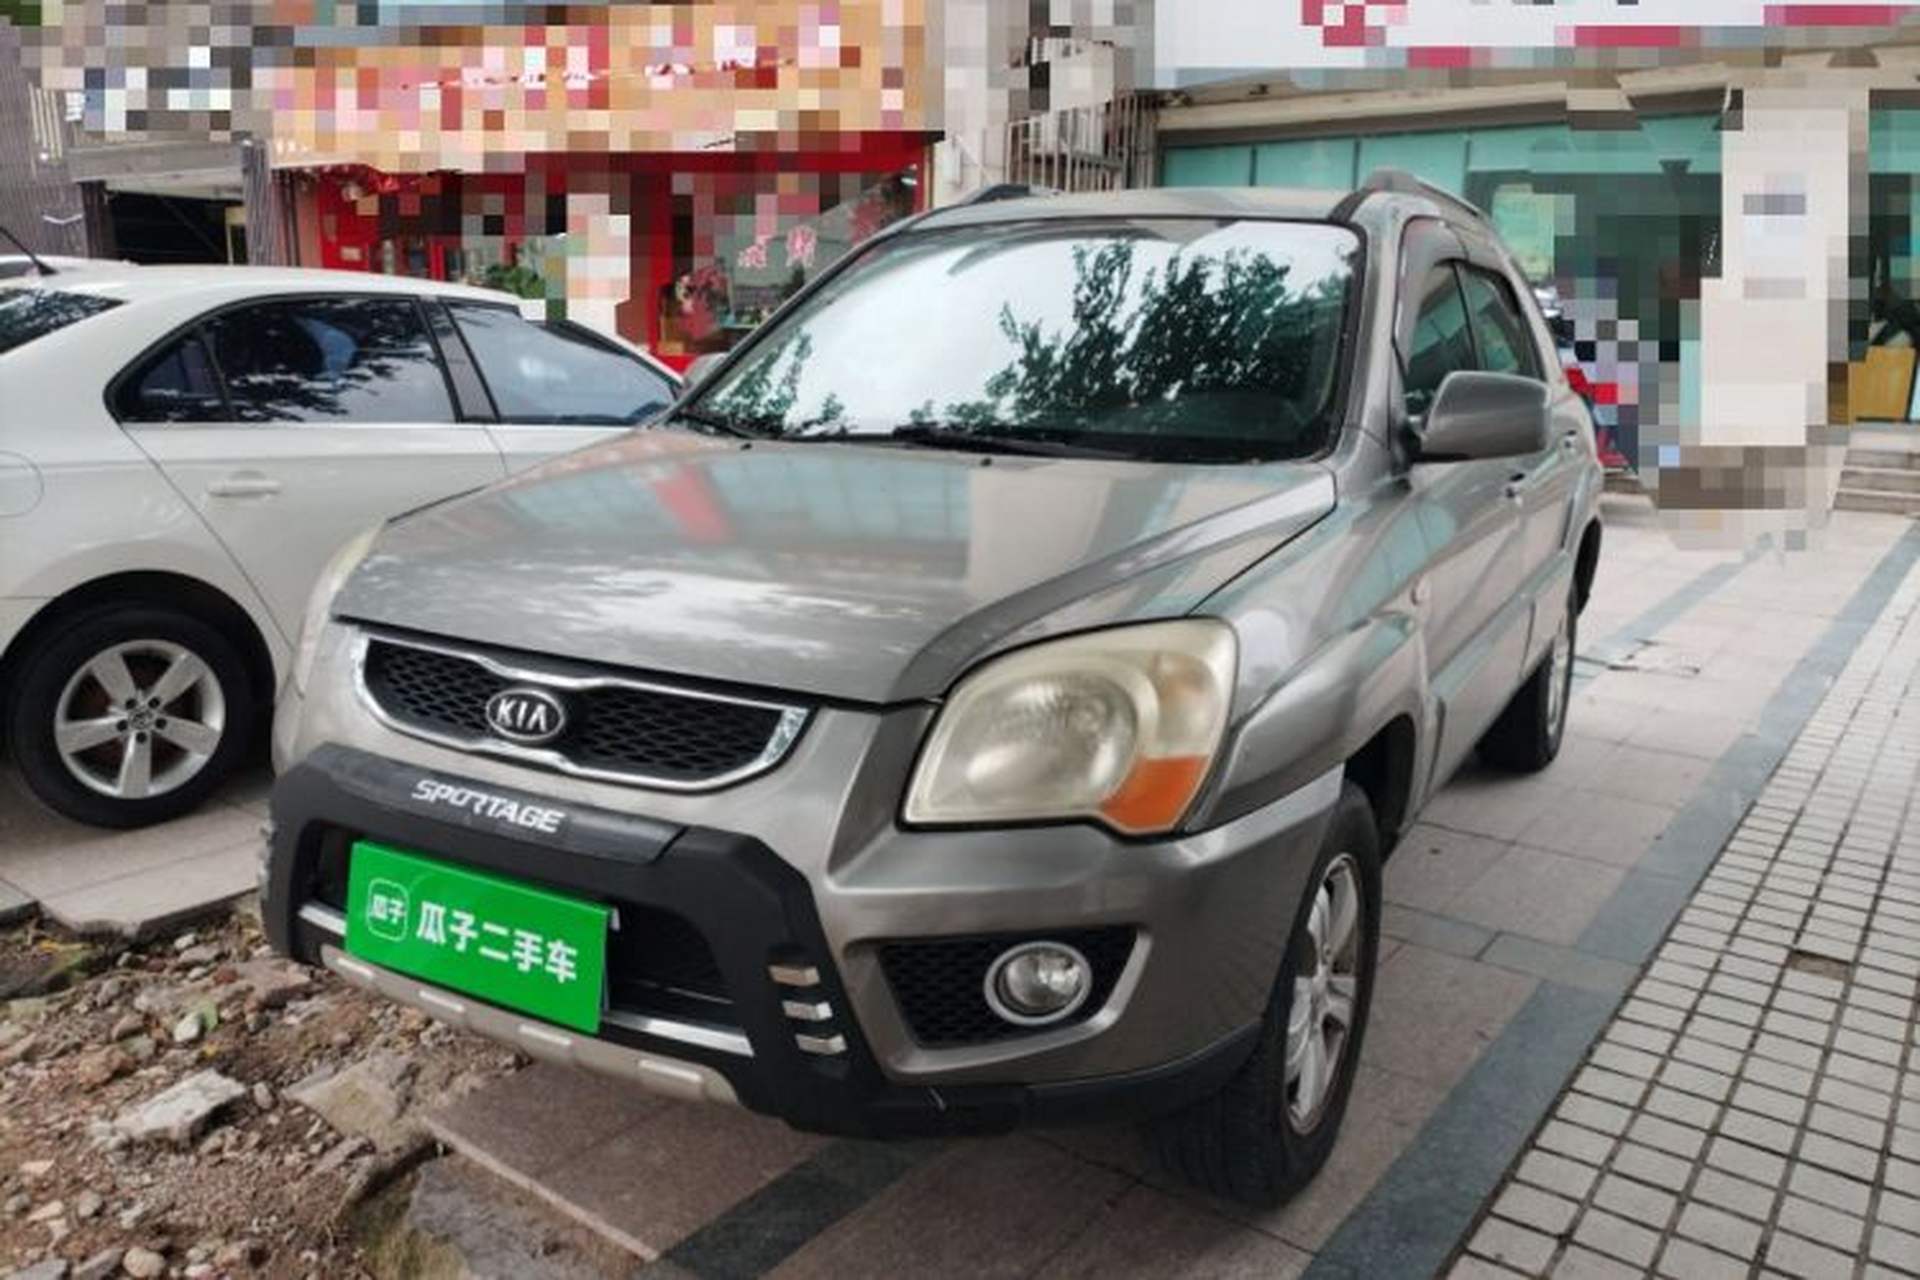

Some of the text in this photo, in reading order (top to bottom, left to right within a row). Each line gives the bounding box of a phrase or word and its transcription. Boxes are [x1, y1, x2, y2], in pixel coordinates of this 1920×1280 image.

[496, 698, 547, 732] KIA
[411, 779, 566, 833] SPORTAGE
[416, 900, 578, 984] 瓜子二手车
